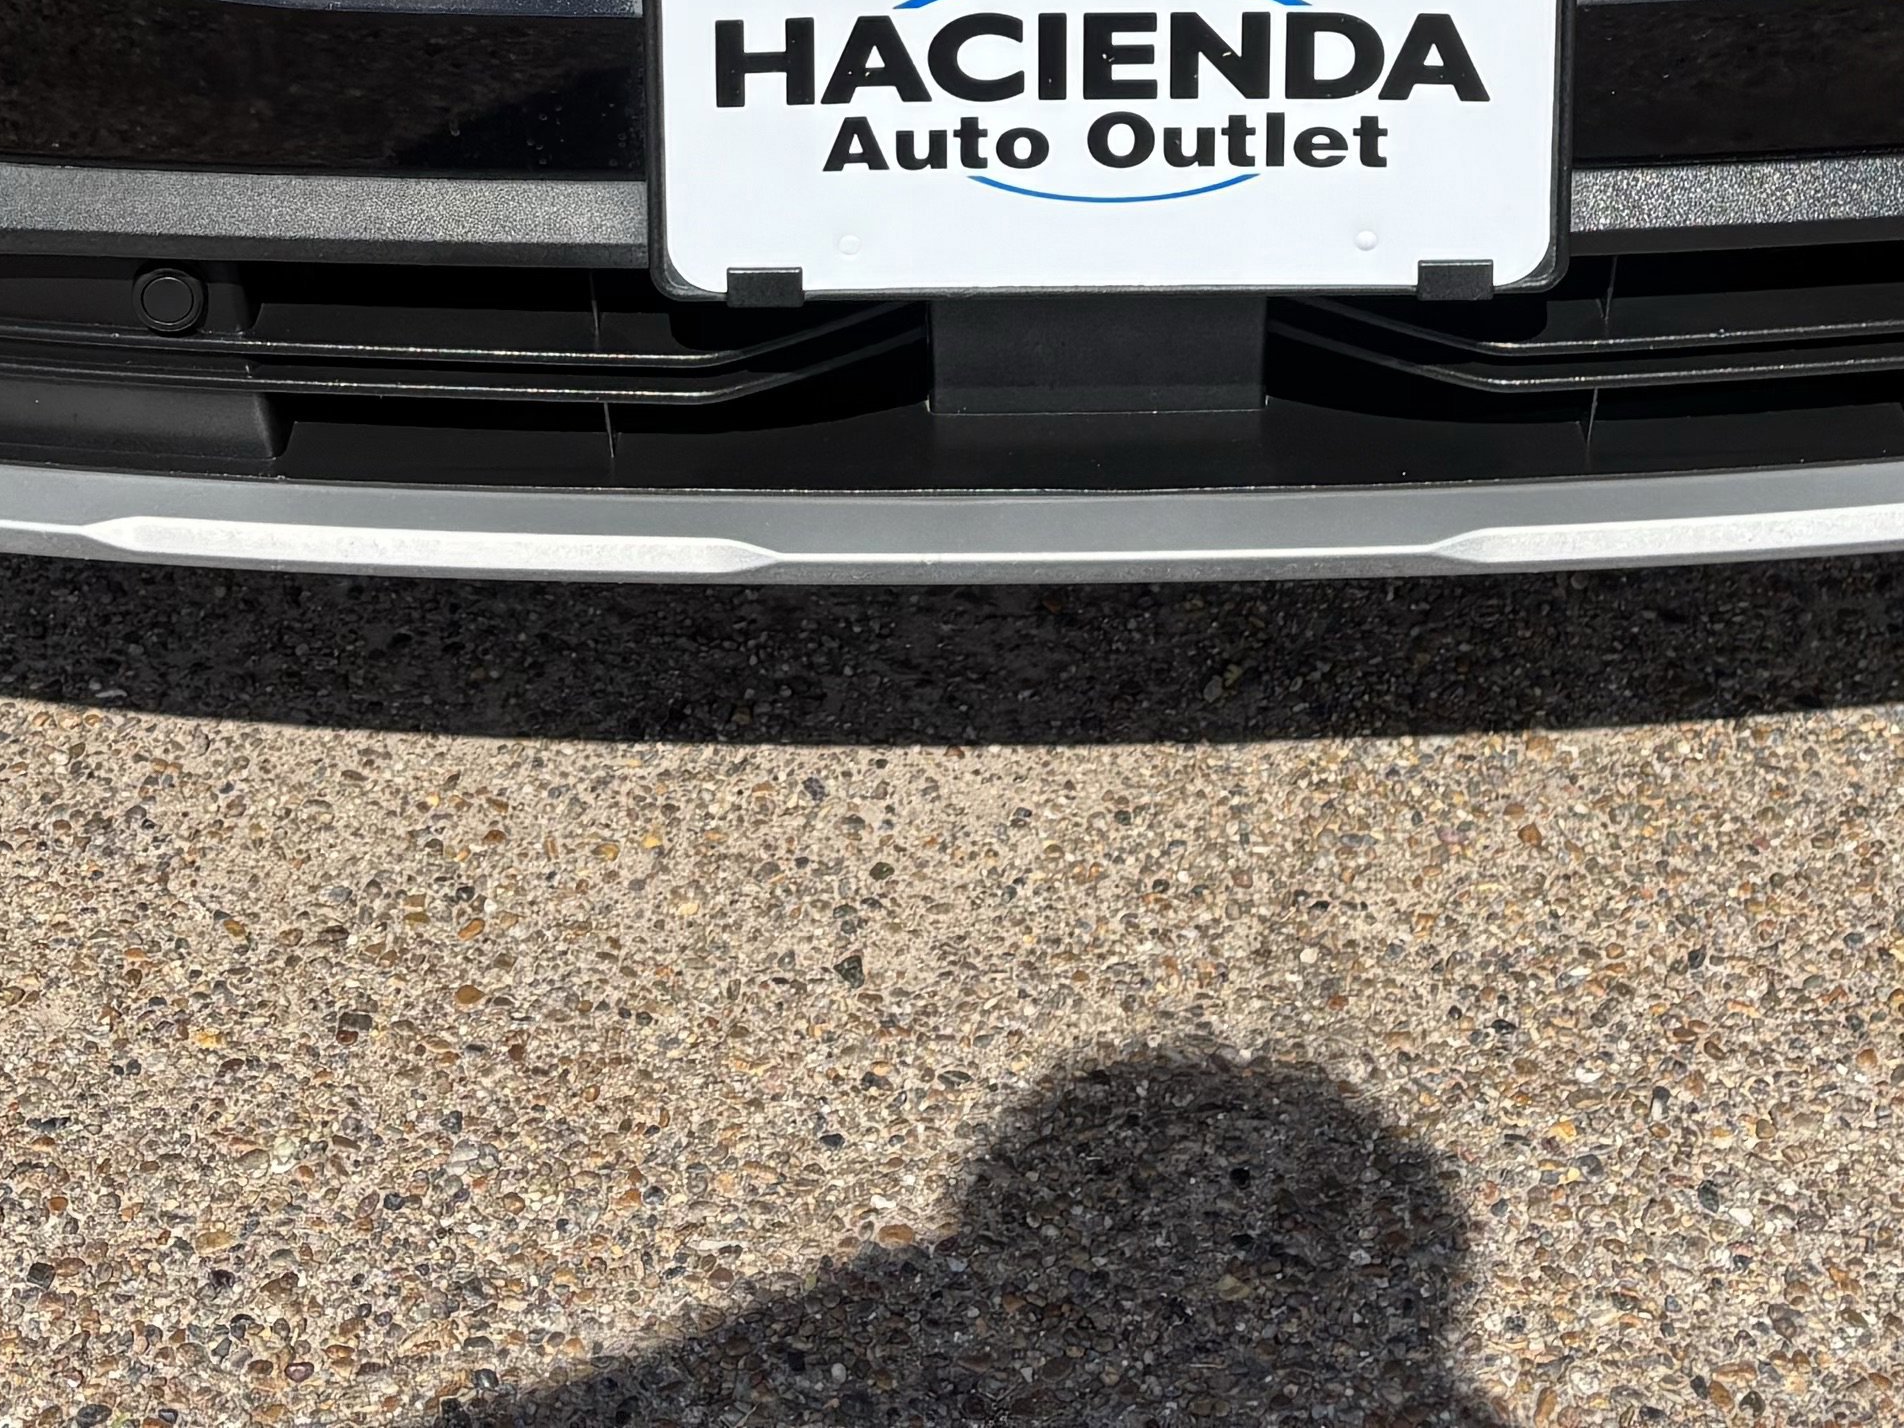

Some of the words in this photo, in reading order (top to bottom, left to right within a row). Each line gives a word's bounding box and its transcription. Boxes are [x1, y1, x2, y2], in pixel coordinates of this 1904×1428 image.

[714, 9, 1491, 109] HACIENDA
[821, 115, 1051, 173] Auto
[1086, 110, 1390, 170] Outlet
